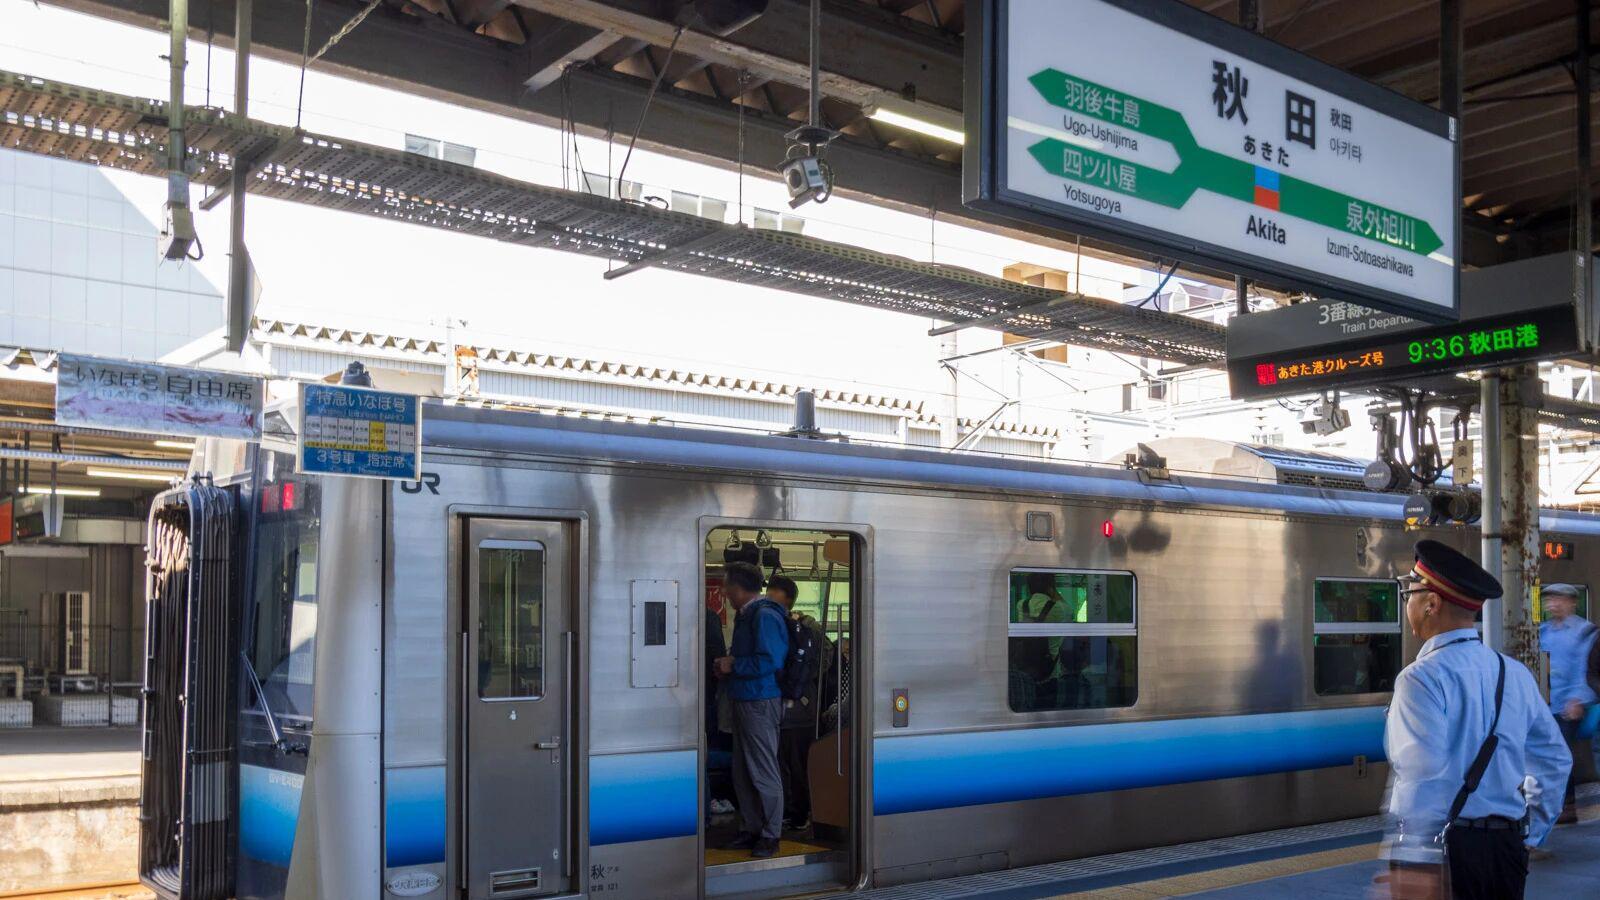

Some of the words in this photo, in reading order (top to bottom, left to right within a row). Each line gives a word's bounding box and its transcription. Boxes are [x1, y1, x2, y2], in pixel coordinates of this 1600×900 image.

[1064, 79, 1141, 128] 羽後牛島
[1212, 60, 1316, 150] 秋田
[1063, 114, 1138, 151] Ugo-Ushijima
[1329, 107, 1352, 133] 秋田
[1243, 134, 1289, 167] あきた
[1329, 137, 1362, 163] 아키타
[1063, 148, 1136, 193] 四ツ小屋
[1063, 183, 1122, 214] Yotsugoya
[1246, 214, 1287, 245] Akita
[1347, 201, 1416, 251] 泉外旭川
[1327, 237, 1413, 277] Izumi-Sotoasahikawa
[1340, 321, 1366, 334] Train
[1408, 335, 1465, 363] 9:36
[1469, 324, 1538, 355] 秋田港
[1278, 351, 1385, 379] あきた港クルーズ号
[317, 389, 407, 413] 特急いなほ号
[316, 450, 355, 465] 3号車
[367, 453, 405, 469] 指定席
[590, 864, 605, 880] 秋
